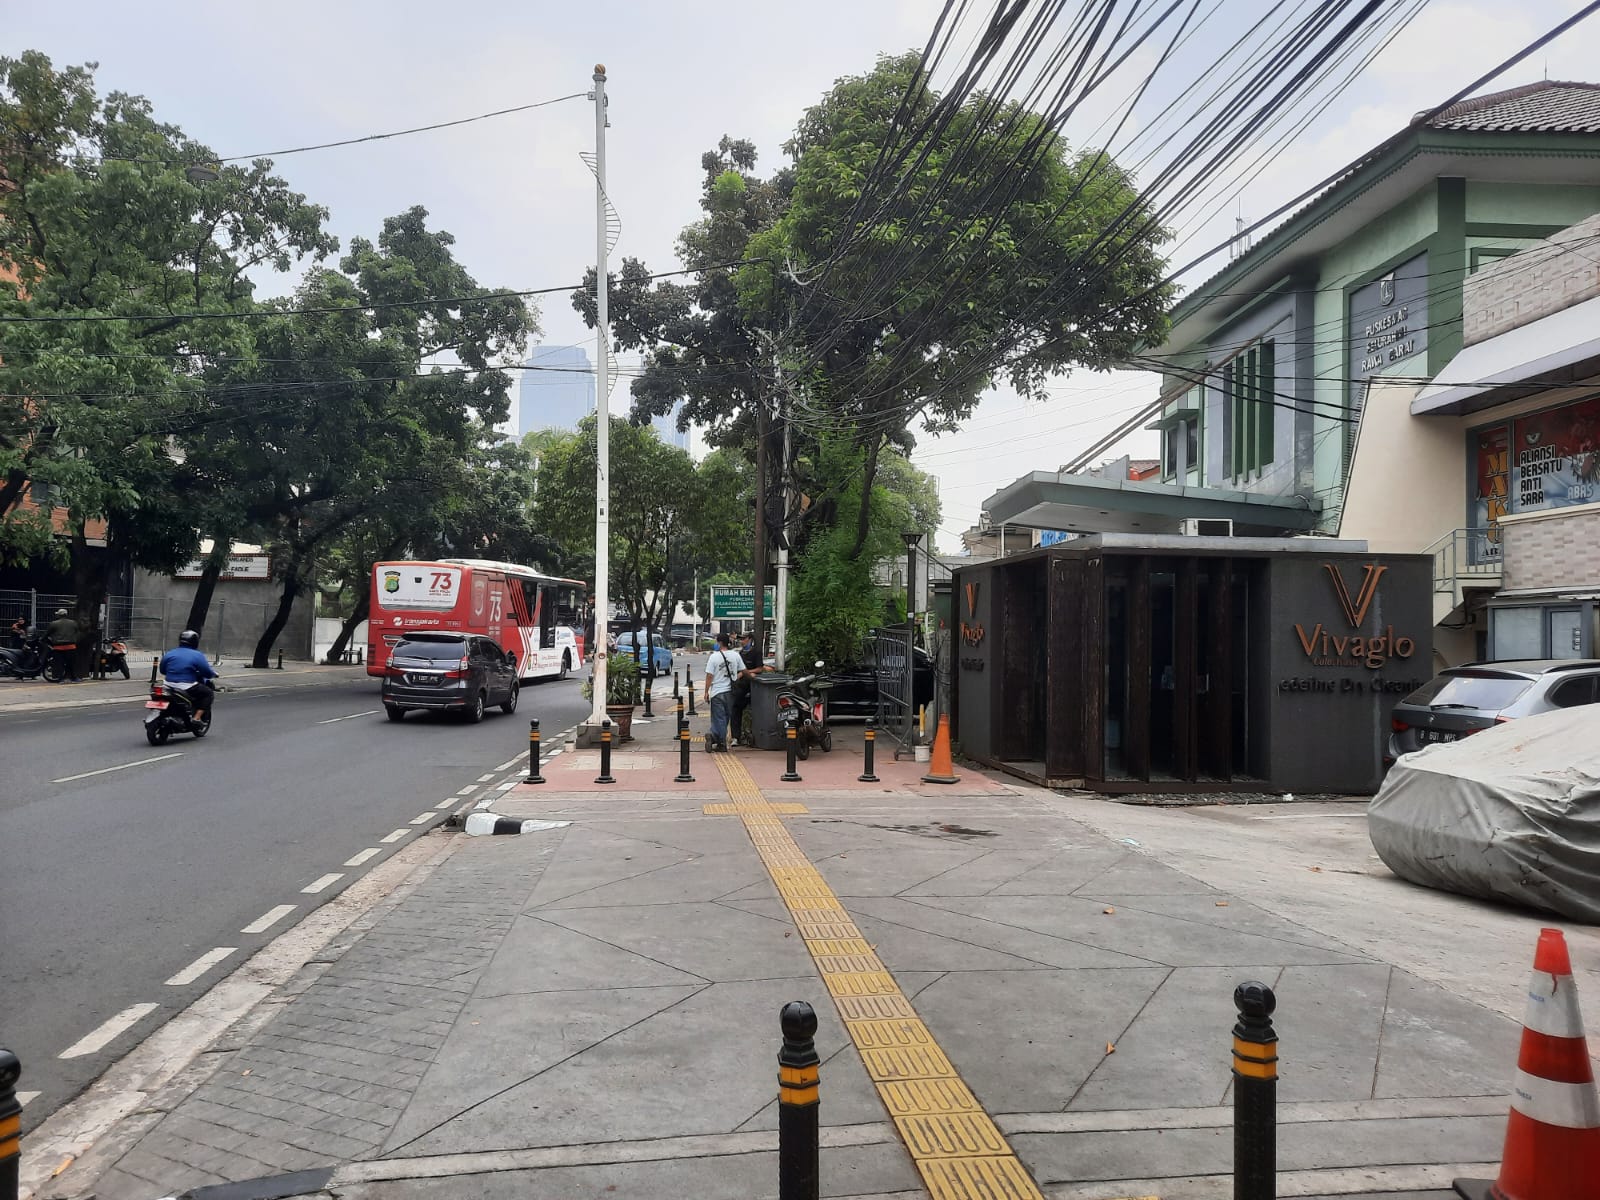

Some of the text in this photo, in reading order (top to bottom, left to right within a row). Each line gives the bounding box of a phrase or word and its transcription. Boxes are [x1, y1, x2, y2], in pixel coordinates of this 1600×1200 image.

[1361, 354, 1383, 373] RAWA
[1520, 444, 1556, 465] ALIANSI
[1520, 458, 1563, 478] BERSATU
[1520, 477, 1542, 492] ANTI
[1567, 483, 1594, 500] ABAS
[1520, 491, 1544, 507] SARA
[429, 572, 452, 590] 73
[714, 589, 739, 597] RUMAH
[1323, 563, 1389, 629] V
[490, 596, 502, 623] 73
[1294, 624, 1416, 669] Vivaglo
